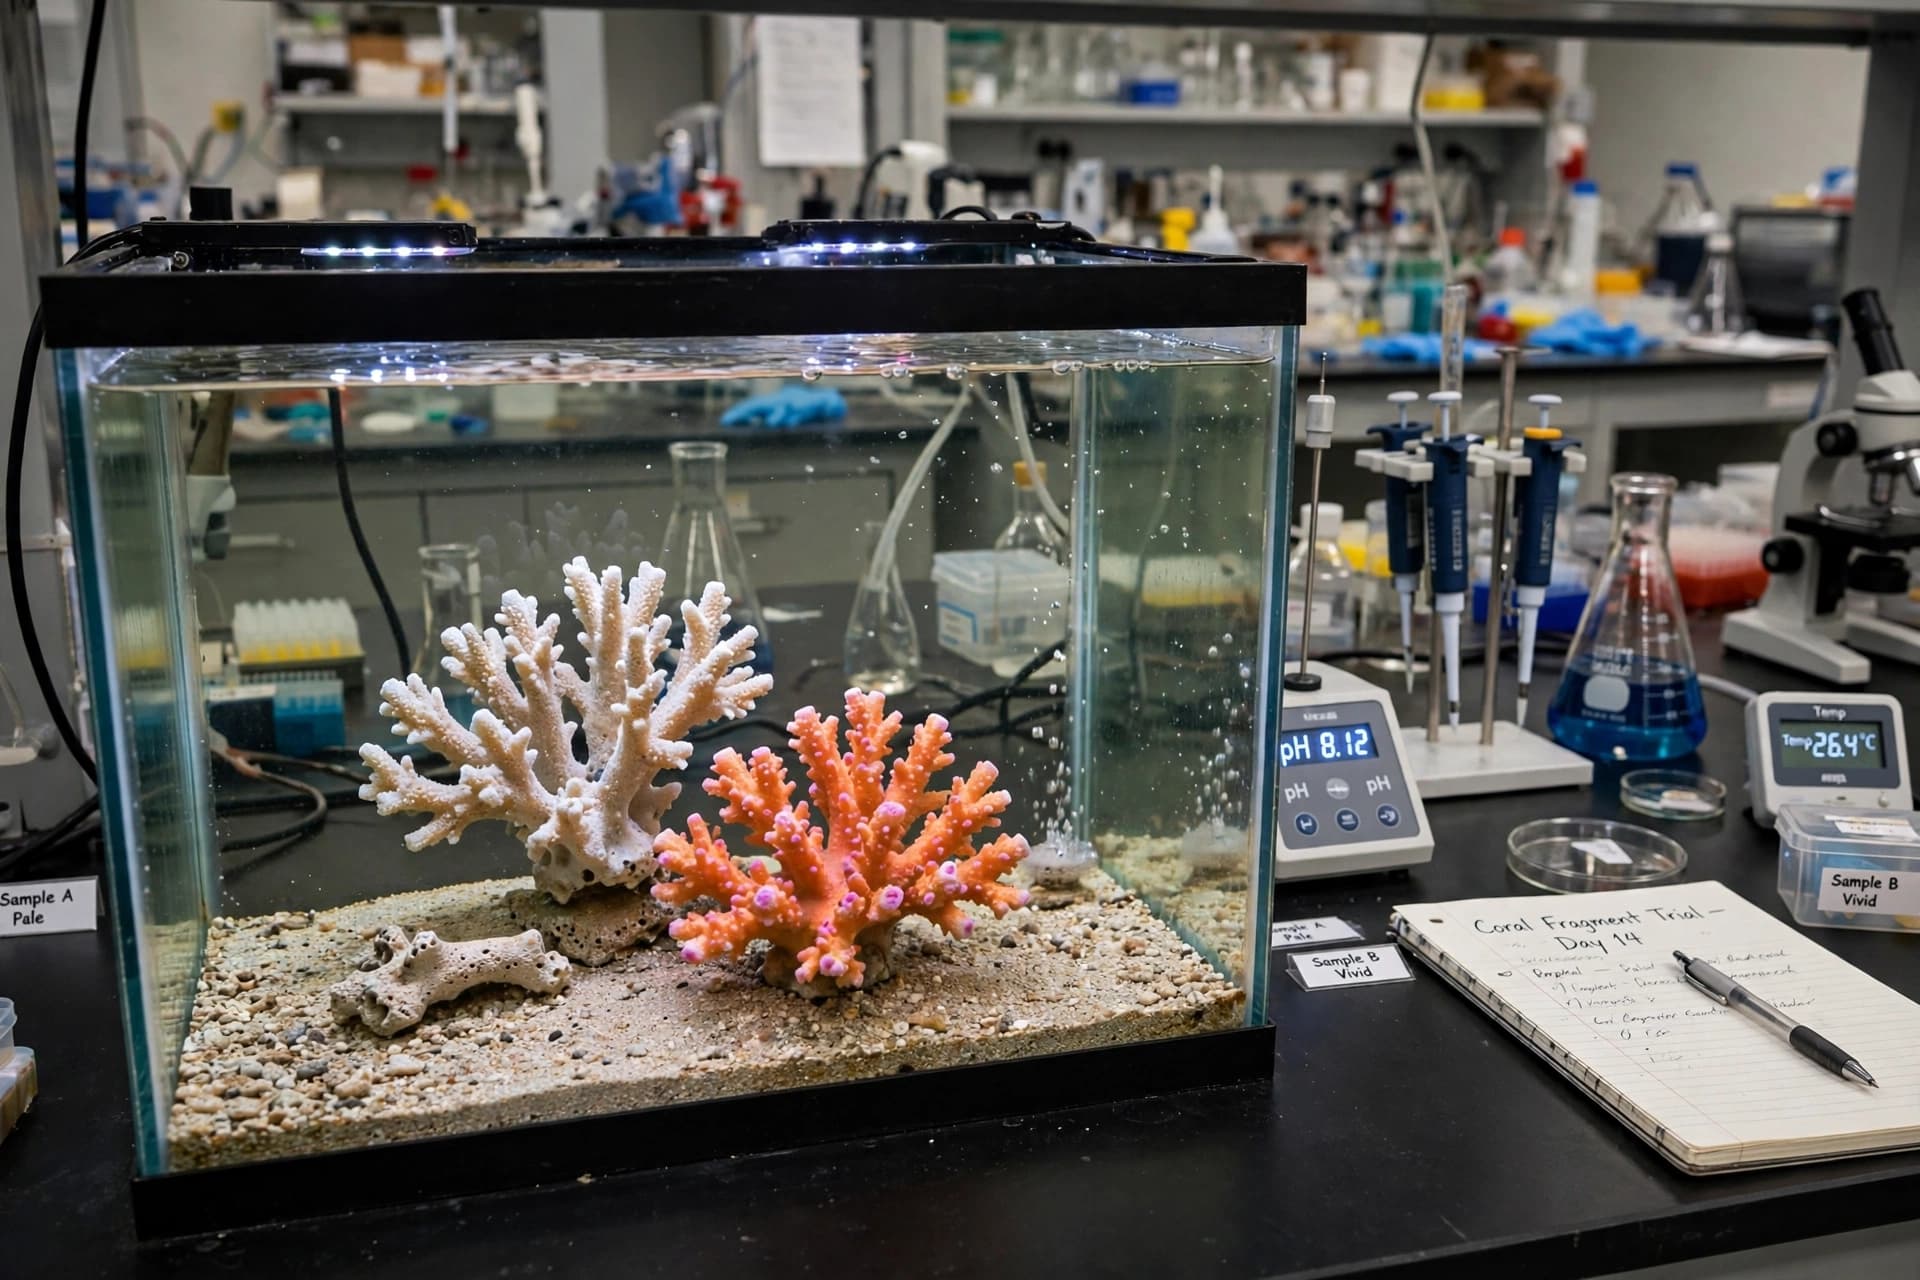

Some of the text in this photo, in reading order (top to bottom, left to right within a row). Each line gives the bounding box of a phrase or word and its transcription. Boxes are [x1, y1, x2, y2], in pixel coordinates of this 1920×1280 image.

[1813, 705, 1847, 721] Temp
[1280, 729, 1369, 766] pH 8.12
[1812, 731, 1876, 758] 26.4°C
[1284, 782, 1310, 804] pH
[1366, 775, 1391, 796] pH
[1831, 874, 1899, 892] Sample B
[0, 887, 74, 909] Sample A
[1843, 893, 1878, 908] Vivid
[13, 910, 45, 926] Pale
[1474, 917, 1534, 935] Coral
[1541, 910, 1642, 935] Fragment
[1645, 905, 1705, 922] Trial
[1554, 931, 1644, 955] Day 14
[1312, 951, 1380, 969] Sample B
[1334, 966, 1374, 980] Vivid
